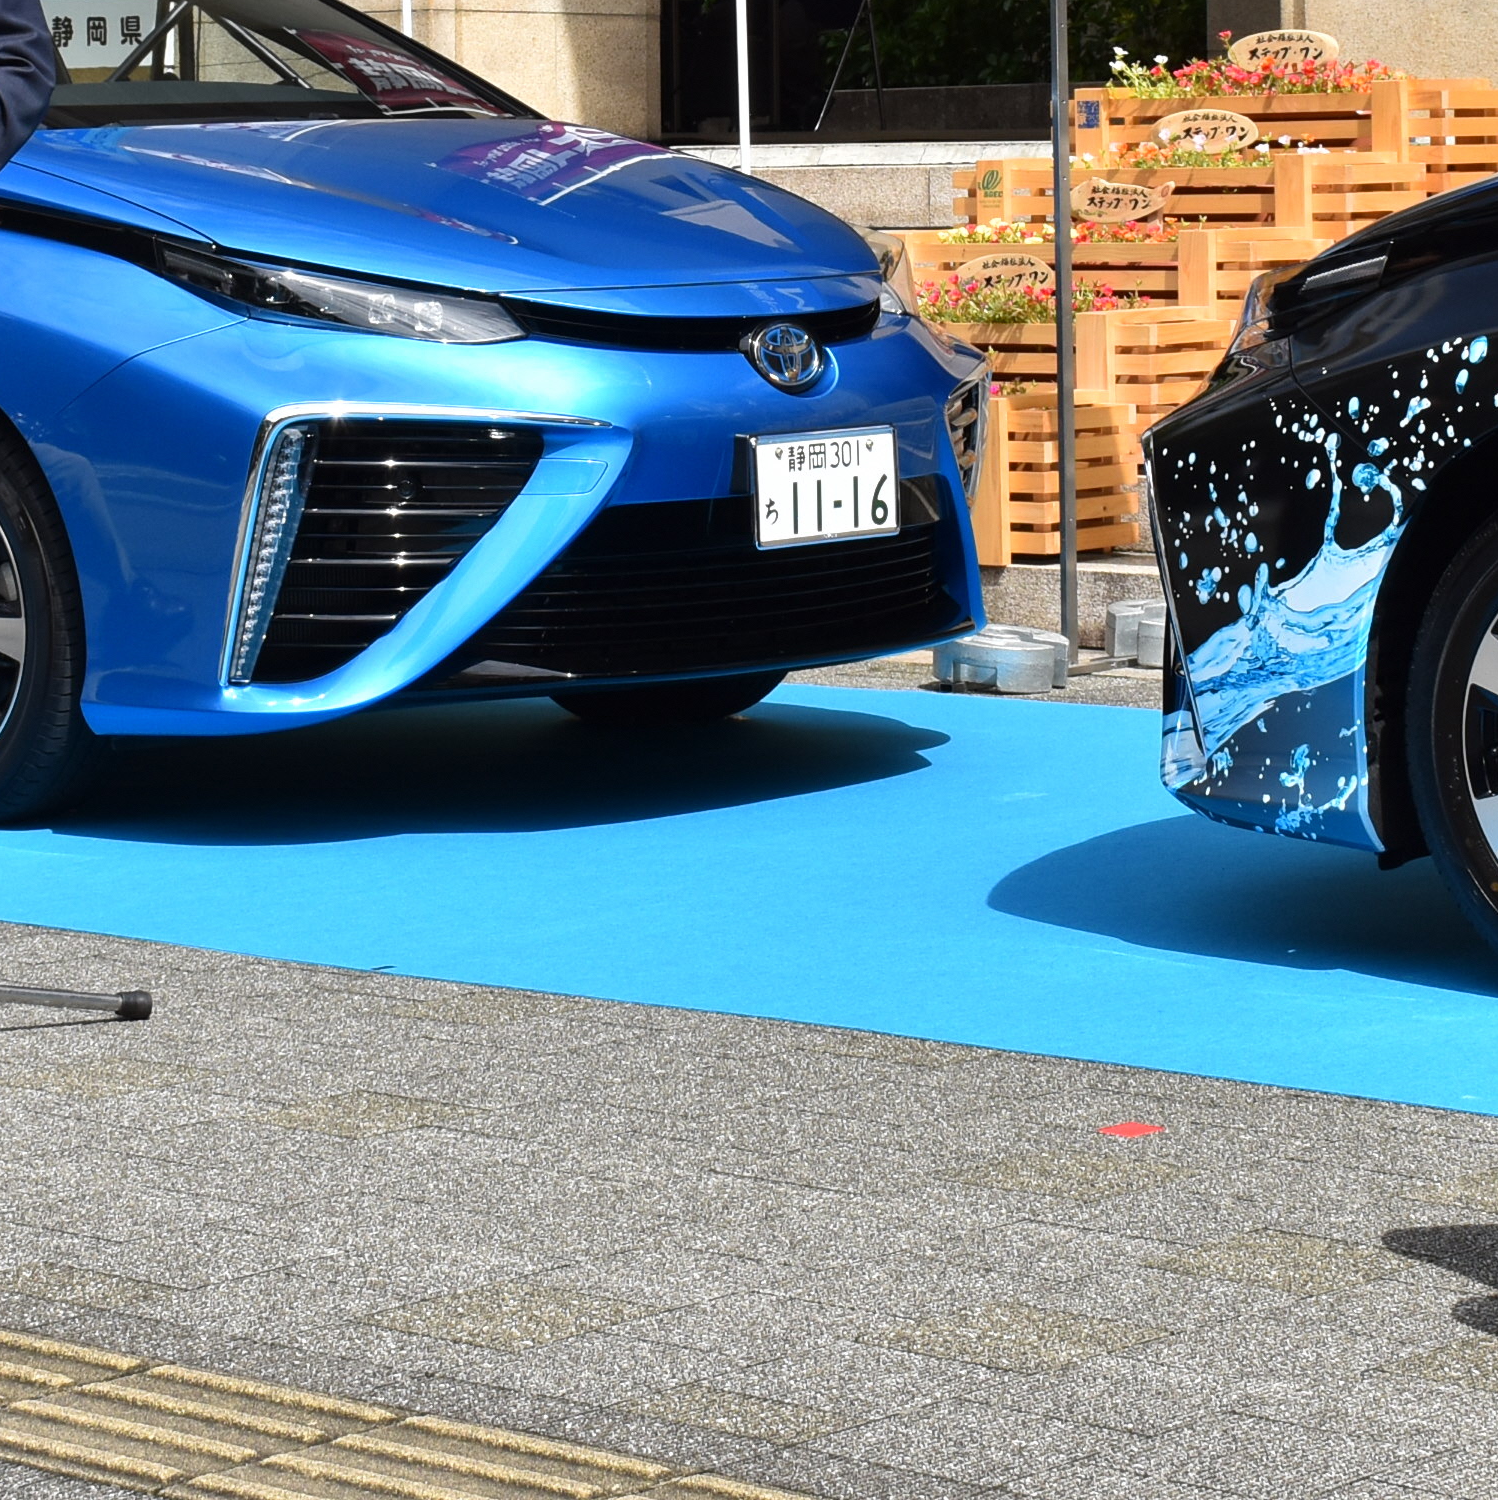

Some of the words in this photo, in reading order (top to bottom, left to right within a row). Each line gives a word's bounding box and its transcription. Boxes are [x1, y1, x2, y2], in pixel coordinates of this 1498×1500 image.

[51, 15, 143, 48] 静岡県
[764, 497, 780, 525] ち
